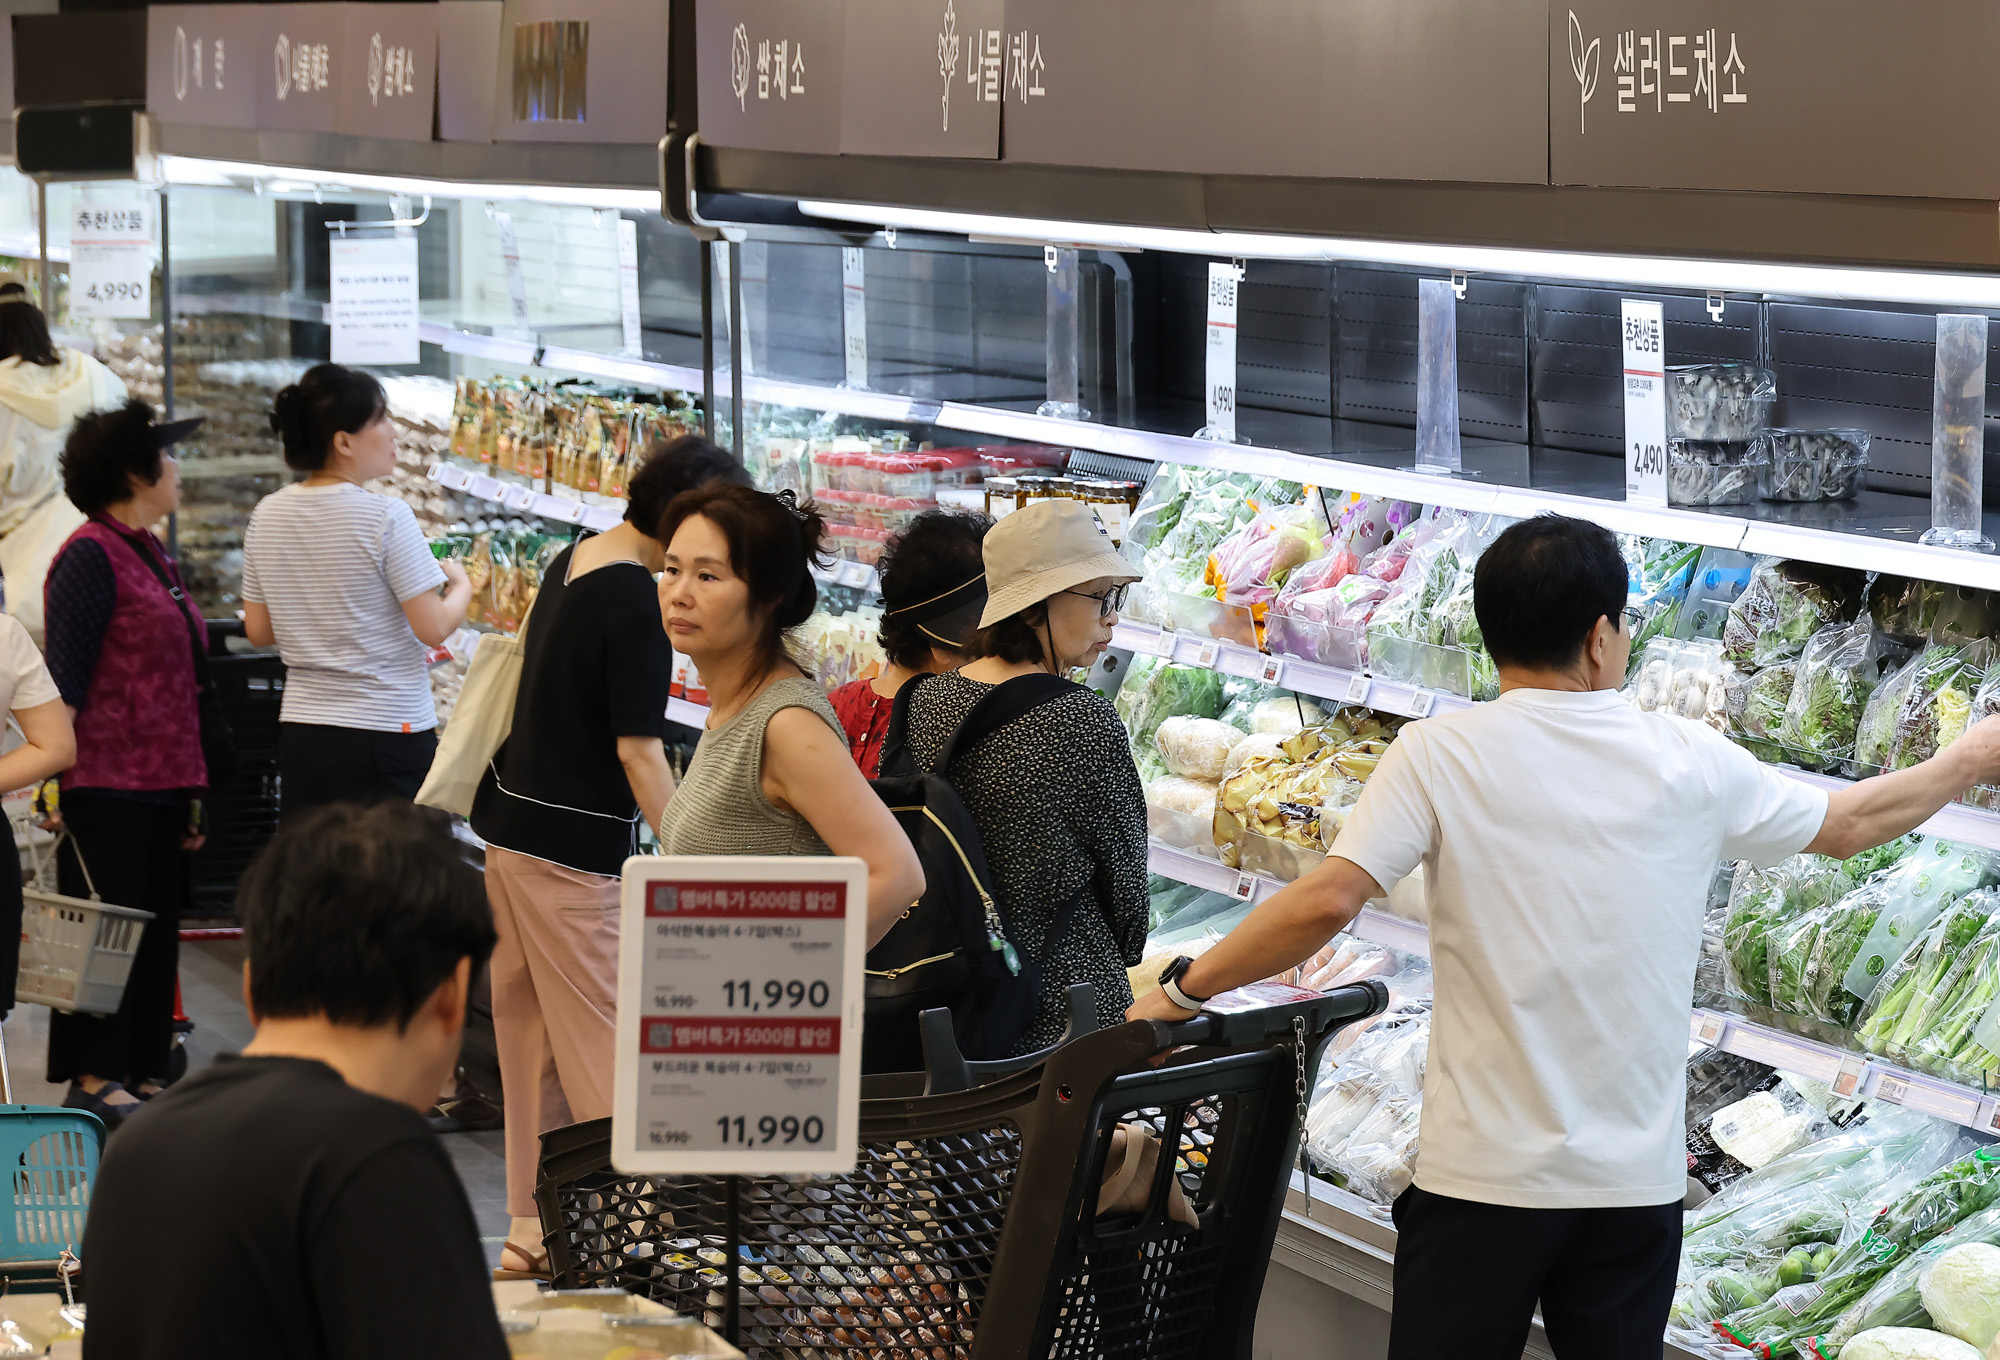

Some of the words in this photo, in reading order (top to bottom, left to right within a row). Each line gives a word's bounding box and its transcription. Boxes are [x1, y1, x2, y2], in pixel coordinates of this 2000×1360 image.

[757, 38, 806, 101] 쌈채소
[1612, 27, 1748, 114] 샐러드채소
[77, 208, 143, 232] 추천상품
[86, 282, 143, 304] 4,990
[1209, 276, 1235, 307] 추천상품
[1625, 317, 1660, 353] 추천상품
[1212, 384, 1233, 415] 4,990
[1634, 442, 1663, 478] 2,490
[749, 890, 801, 911] 5000원
[805, 890, 837, 912] 할인
[722, 979, 830, 1013] 11,990
[744, 1026, 796, 1047] 5000원
[800, 1027, 832, 1047] 할인
[717, 1115, 825, 1148] 11,990
